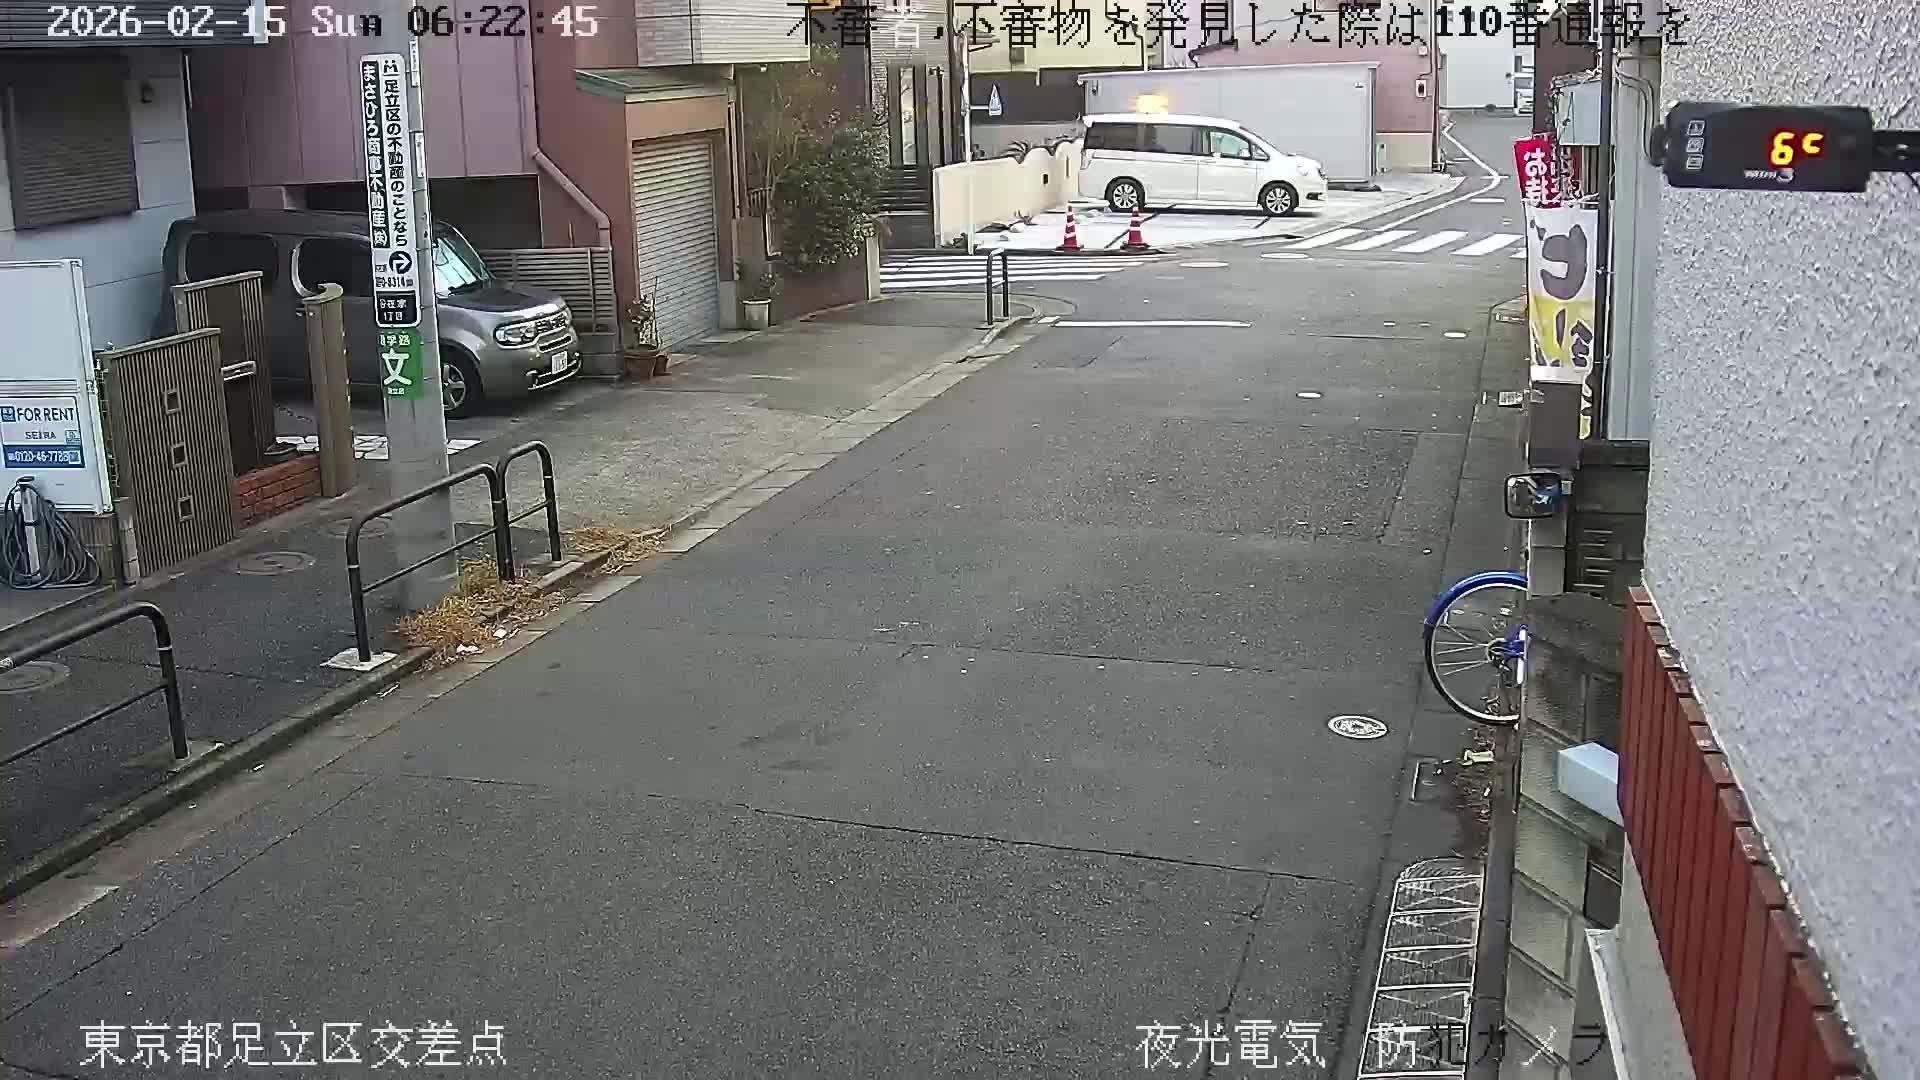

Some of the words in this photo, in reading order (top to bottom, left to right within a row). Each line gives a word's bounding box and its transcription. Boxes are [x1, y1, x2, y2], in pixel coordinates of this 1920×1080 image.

[382, 347, 412, 386] 文
[17, 407, 42, 421] FOR
[43, 407, 74, 421] RENT
